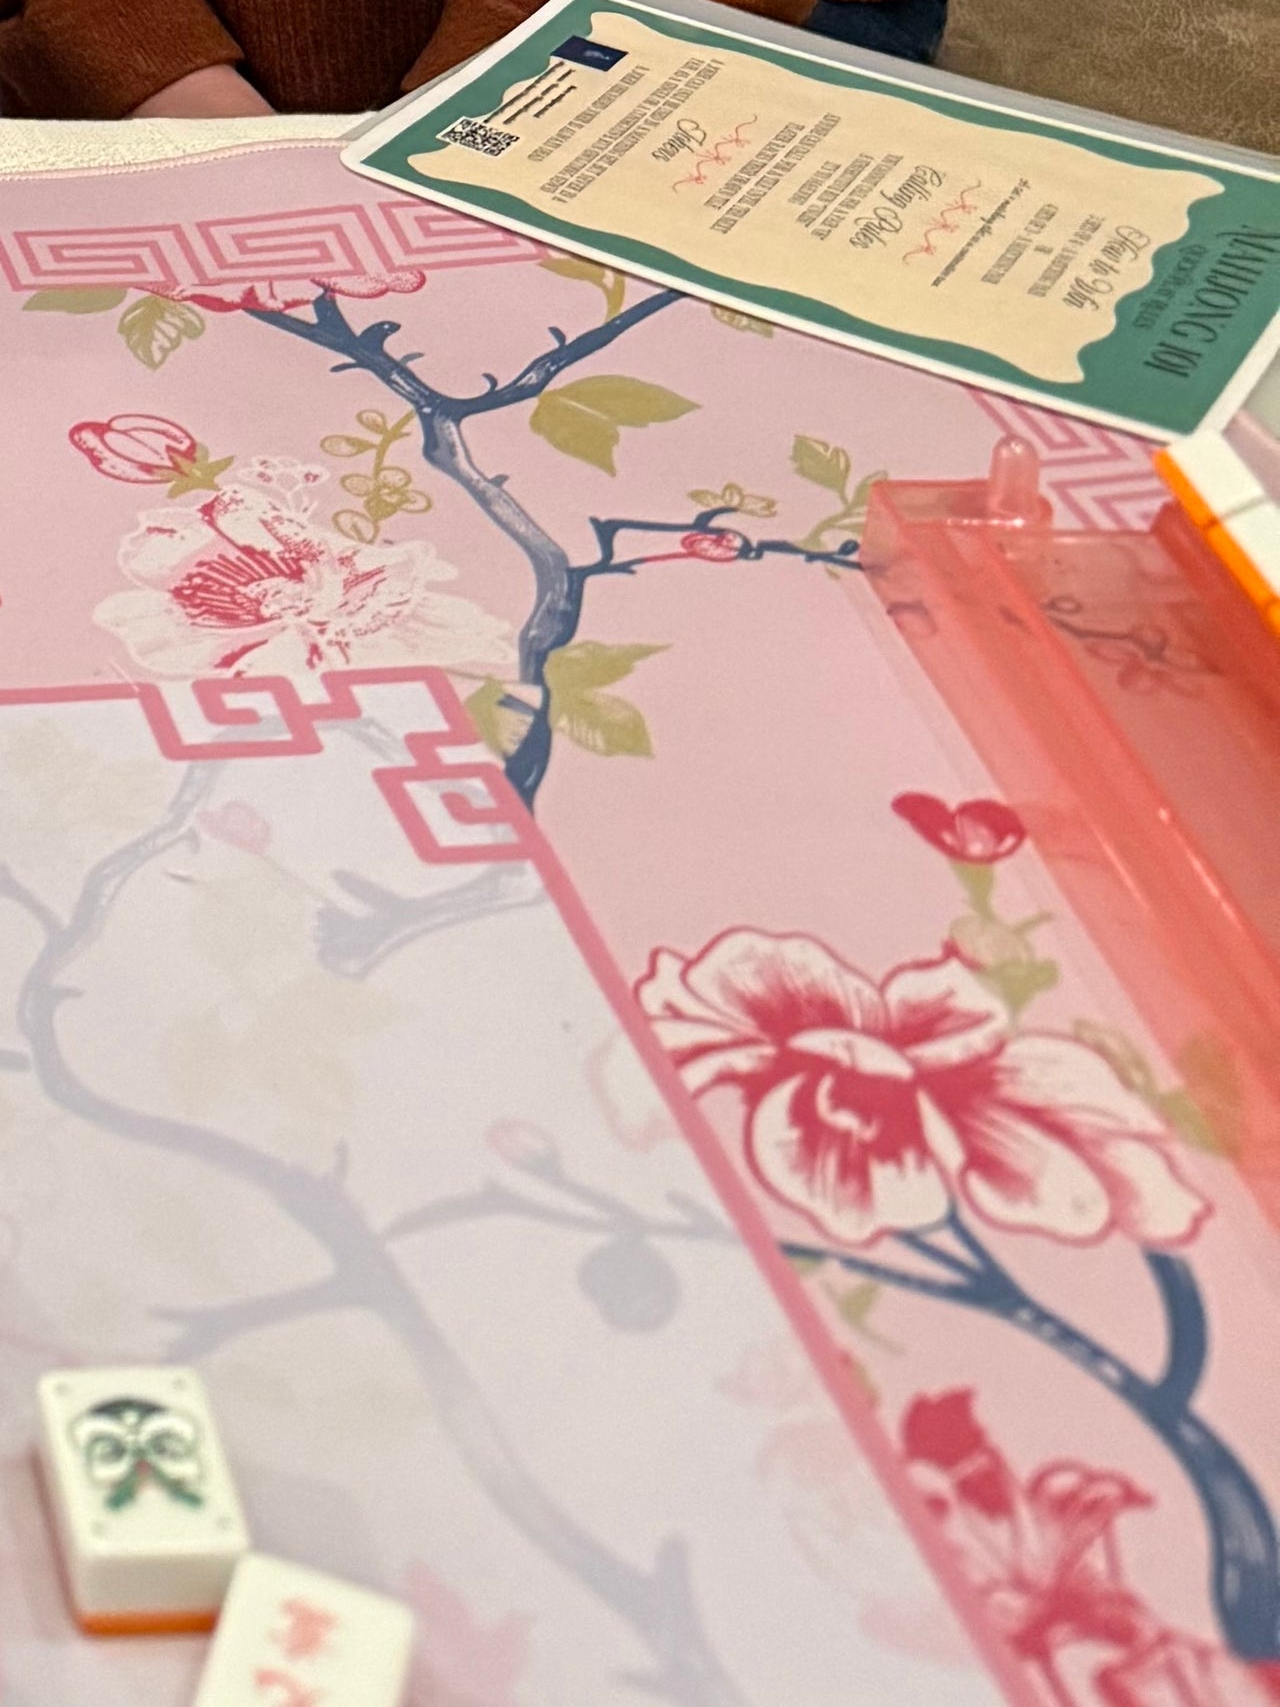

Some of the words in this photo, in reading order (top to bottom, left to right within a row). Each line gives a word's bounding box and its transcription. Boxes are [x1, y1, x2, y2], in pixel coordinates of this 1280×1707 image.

[880, 166, 946, 208] Calling
[850, 208, 903, 248] Rules
[1101, 226, 1150, 262] How
[1089, 259, 1115, 276] to
[1171, 225, 1279, 342] MAHJONG
[1063, 277, 1114, 311] Win
[1144, 342, 1202, 377] 101
